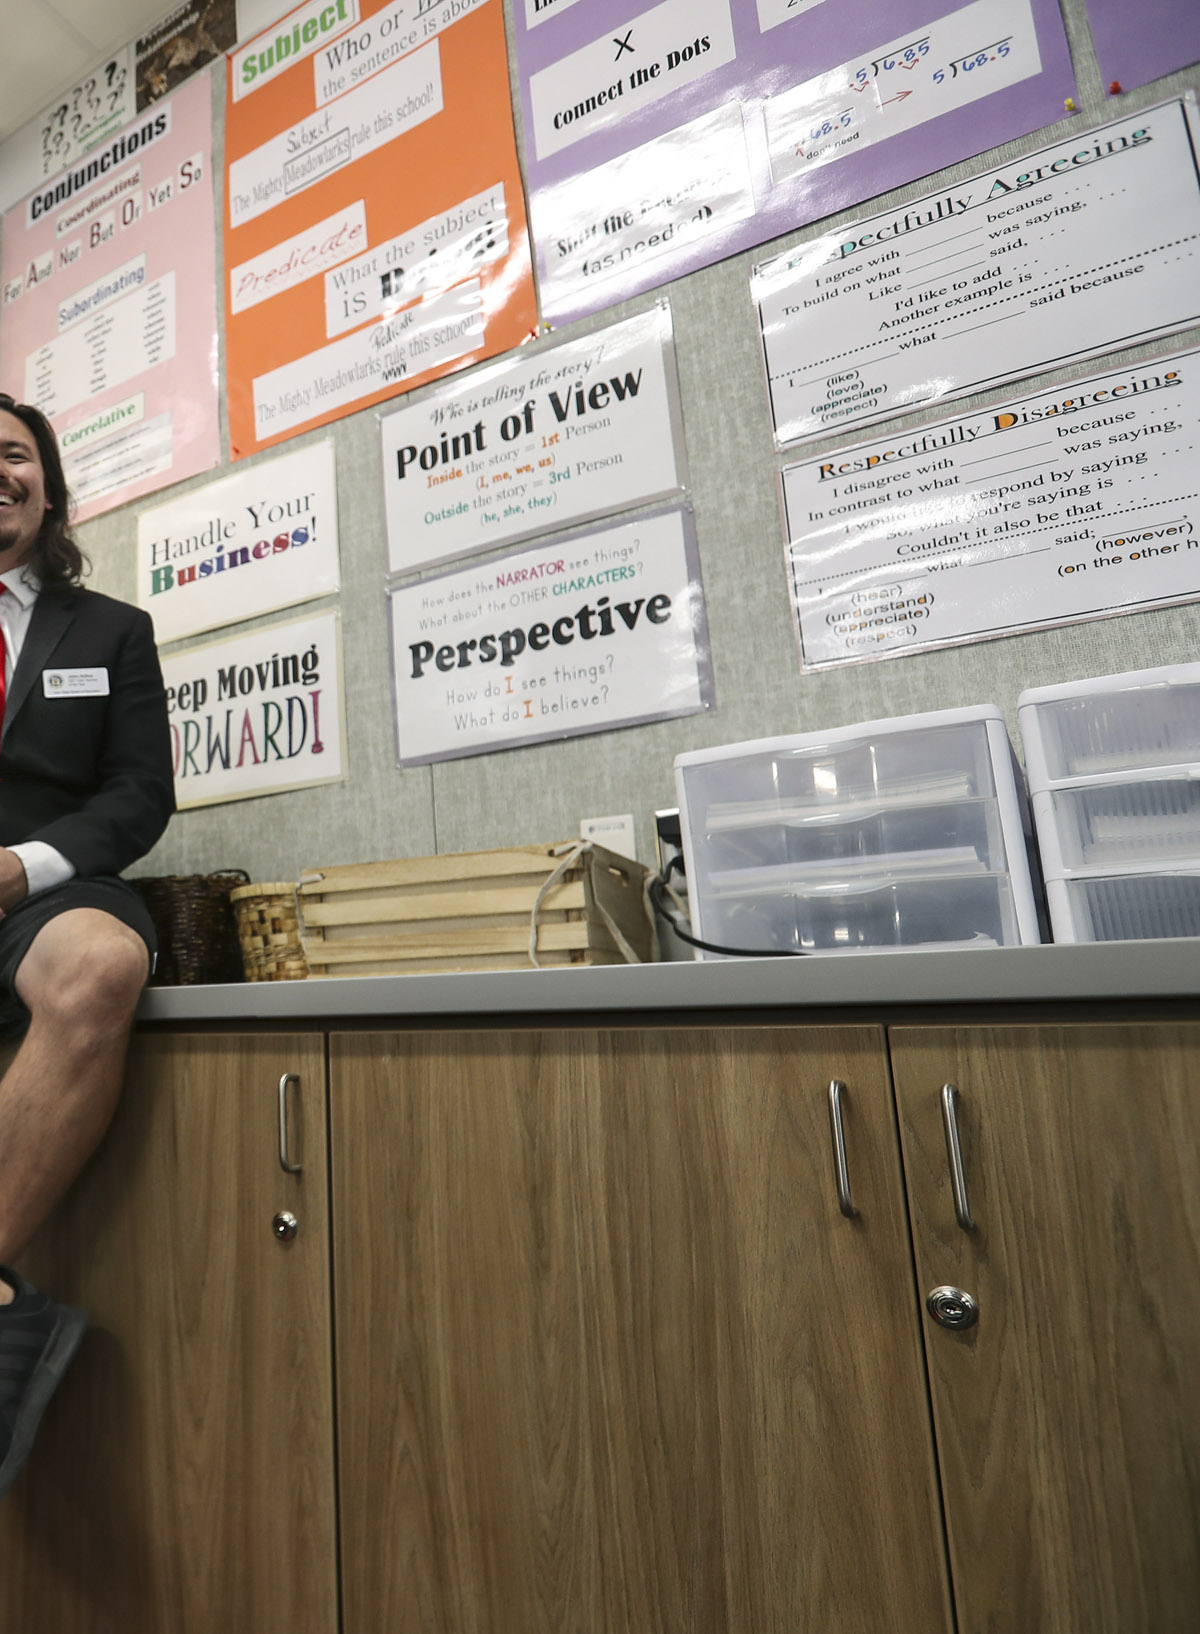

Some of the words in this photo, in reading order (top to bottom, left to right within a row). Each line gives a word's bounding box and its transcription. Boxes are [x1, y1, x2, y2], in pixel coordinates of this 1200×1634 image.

[241, 0, 349, 85] Subject
[323, 76, 346, 99] the
[350, 28, 418, 82] sentence
[423, 17, 437, 37] is
[325, 31, 372, 71] Who
[380, 9, 404, 38] or
[962, 41, 1011, 73] 68.5
[553, 79, 624, 131] Connect
[630, 61, 662, 91] the
[666, 34, 712, 72] Dots
[30, 112, 167, 221] Conjunctions
[986, 125, 1154, 202] Agreeing
[3, 282, 22, 304] For
[27, 261, 53, 290] And
[59, 243, 82, 269] Nor
[89, 220, 114, 250] But
[122, 198, 142, 227] Or
[150, 183, 171, 209] Yet
[179, 160, 202, 190] So
[57, 170, 142, 233] Coordinating
[236, 222, 363, 298] Predicate
[332, 260, 378, 291] What
[385, 239, 416, 265] the
[423, 195, 498, 246] subject
[868, 282, 903, 302] Like
[989, 238, 1028, 259] said,
[58, 266, 145, 326] Subordinating
[342, 291, 368, 319] is
[878, 307, 938, 332] Another
[944, 280, 1015, 314] example
[1019, 272, 1033, 284] is
[810, 383, 889, 415] (appreciate)
[820, 397, 879, 424] (respect)
[826, 369, 860, 387] (like)
[826, 380, 865, 400] (love)
[61, 402, 136, 448] Correlative
[396, 419, 487, 480] Point
[500, 399, 537, 441] of
[548, 367, 643, 424] View
[426, 466, 464, 489] Inside
[465, 457, 485, 475] the
[488, 447, 521, 471] story
[565, 415, 612, 440] Person
[818, 423, 982, 483] Respectfully
[994, 369, 1184, 433] Disagreeing
[832, 487, 839, 498] I
[843, 470, 912, 497] disagree
[916, 457, 954, 477] with
[1056, 408, 1136, 438] because
[424, 501, 470, 526] Outside
[472, 493, 493, 511] the
[495, 482, 528, 506] story
[548, 468, 572, 487] 3rd
[576, 452, 624, 477] Person
[808, 510, 824, 522] In
[828, 492, 892, 517] contrast
[897, 487, 913, 499] to
[918, 474, 961, 493] what
[1064, 440, 1102, 455] was
[1108, 419, 1183, 447] saying,
[1050, 467, 1074, 484] by
[1081, 450, 1149, 476] saying
[149, 516, 318, 597] Business!
[151, 517, 237, 567] Handle
[247, 491, 316, 531] Your
[896, 531, 970, 556] Couldn't
[975, 526, 989, 538] it
[994, 515, 1032, 534] also
[1037, 508, 1061, 524] be
[1064, 500, 1104, 518] that
[1057, 559, 1087, 578] (on
[1093, 553, 1123, 569] the
[1129, 542, 1181, 562] other
[1095, 520, 1194, 553] (however)
[418, 615, 449, 632] What
[452, 606, 484, 624] about
[487, 599, 507, 614] the
[509, 587, 549, 608] OTHER
[552, 562, 644, 598] CHARACTERS?
[421, 596, 445, 610] How
[449, 587, 473, 604] does
[476, 580, 494, 596] the
[496, 559, 565, 589] NARRATOR
[569, 557, 589, 571] see
[595, 538, 641, 563] things?
[825, 592, 936, 626] (understand)
[408, 592, 672, 680] Perspective
[833, 606, 931, 637] (appreciate)
[164, 676, 208, 716] eep
[217, 643, 320, 702] Moving
[454, 711, 496, 731] What
[502, 705, 520, 722] do
[523, 699, 534, 719] I
[541, 685, 610, 716] believe?
[169, 689, 324, 779] ORWARD!
